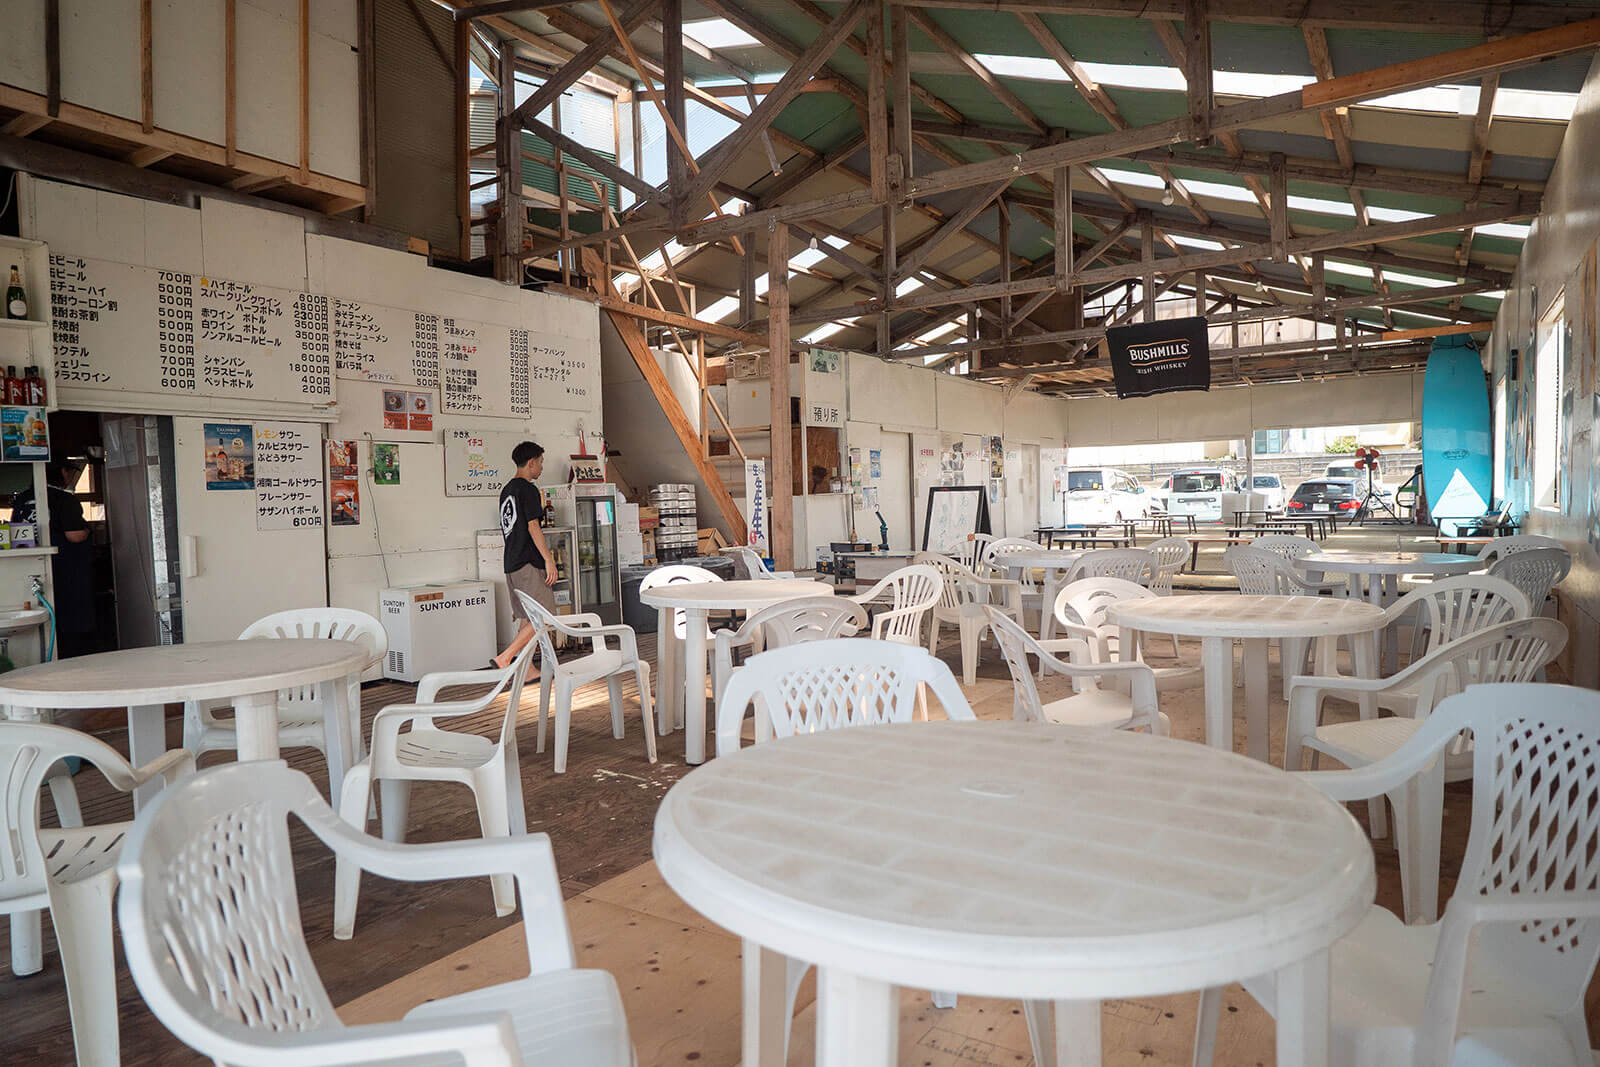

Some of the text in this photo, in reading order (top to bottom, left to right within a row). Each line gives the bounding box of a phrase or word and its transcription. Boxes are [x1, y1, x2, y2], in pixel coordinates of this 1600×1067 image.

[158, 271, 192, 285] 700円
[158, 283, 192, 297] 500円
[159, 295, 193, 308] 500円
[158, 307, 193, 321] 500円
[158, 319, 193, 333] 500円
[159, 331, 194, 344] 500円
[295, 330, 329, 342] 3500円
[159, 343, 194, 356] 500円
[301, 342, 329, 353] 500円
[1129, 343, 1188, 361] BUSHMILLS
[160, 355, 195, 368] 700円
[1154, 362, 1188, 371] WHISKEY
[161, 366, 195, 379] 700円
[161, 378, 195, 390] 600円
[301, 375, 330, 386] 400円
[302, 385, 331, 395] 200円
[292, 516, 322, 527] 600円
[14, 528, 29, 539] 15
[420, 596, 486, 613] SUNTORY BEER
